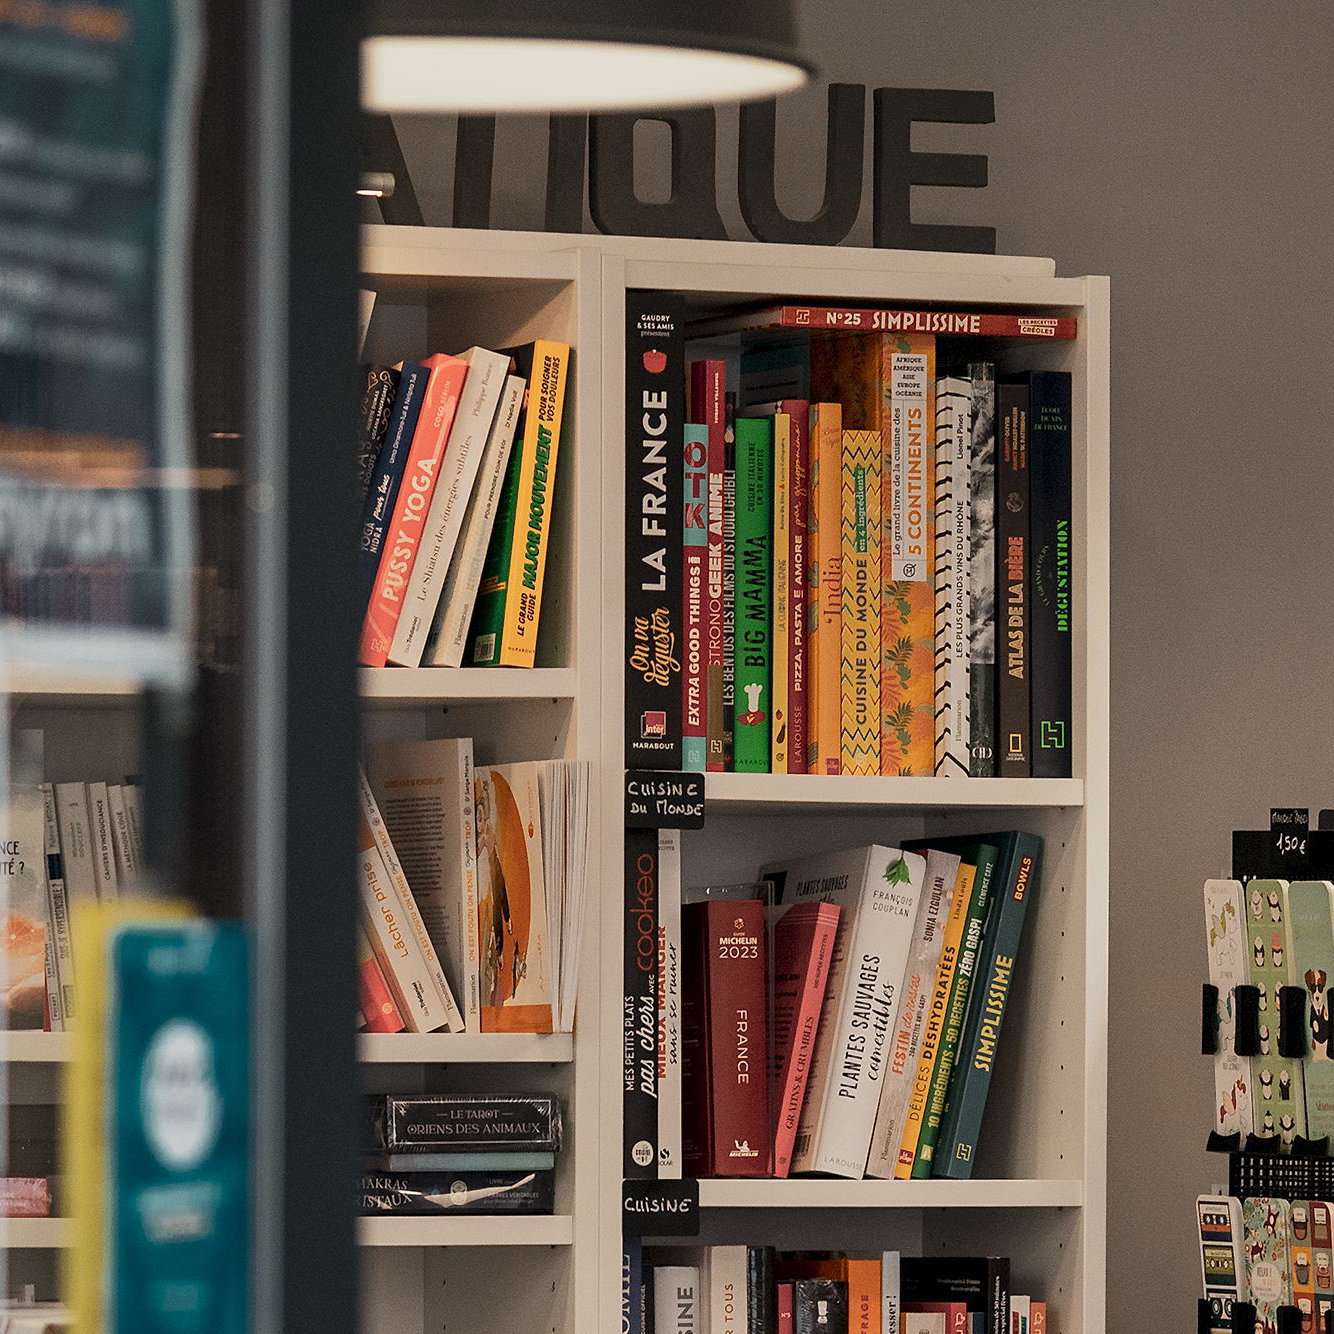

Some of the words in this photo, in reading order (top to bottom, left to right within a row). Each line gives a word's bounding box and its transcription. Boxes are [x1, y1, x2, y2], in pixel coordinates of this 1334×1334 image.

[641, 314, 670, 322] GAUDRY
[872, 311, 980, 332] SIMPLISSIME
[541, 356, 552, 396] SOIGNER
[548, 357, 560, 403] DOULEURS
[539, 397, 549, 422] POUR
[546, 405, 556, 422] VOS
[454, 435, 472, 475] subtiles
[642, 390, 667, 537] FRANCE
[907, 407, 922, 540] CONTINENTS
[528, 424, 552, 532] MOUVEMENT
[438, 478, 461, 522] énergies
[382, 531, 415, 602] PUSSY
[403, 458, 437, 523] YOGA
[433, 524, 447, 543] des
[907, 544, 922, 556] 5
[956, 535, 963, 551] DU
[421, 545, 442, 585] Shiatsu
[522, 530, 541, 590] MAJOR
[642, 547, 667, 591] LA
[741, 535, 767, 621] MAMMA
[794, 535, 803, 585] AMORE
[1004, 536, 1024, 581] BIÈRE
[417, 587, 427, 602] Le
[518, 593, 528, 625] GRAND
[527, 593, 537, 622] GUIDE
[688, 566, 701, 625] THINGS
[857, 559, 866, 622] MONDE
[1008, 583, 1024, 604] LA
[517, 626, 525, 637] LE
[794, 603, 803, 646] PASTA
[1008, 605, 1024, 627] DE
[688, 628, 701, 674] GOOD
[740, 629, 766, 667] BIG
[857, 628, 866, 652] DU
[1008, 630, 1024, 679] ATLAS
[794, 650, 803, 692] PIZZA,
[857, 657, 866, 725] CUISINE
[688, 677, 701, 726] EXTRA
[19, 861, 25, 876] ?
[363, 862, 388, 902] prise
[1014, 857, 1032, 900] BOWLS
[630, 854, 654, 970] cookeo
[928, 876, 944, 916] EZGULIAN
[380, 906, 408, 959] Lâcher
[719, 937, 758, 945] MICHELIN
[923, 917, 937, 942] SONIA
[966, 918, 983, 949] GASPI
[719, 945, 759, 959] 2023
[958, 950, 976, 977] ZÉRO
[625, 995, 635, 1026] PLATS
[851, 954, 880, 1030] SAUVAGES
[949, 978, 970, 1025] RECETTES
[974, 954, 1013, 1072] SIMPLISSIME
[635, 996, 655, 1050] chers
[866, 981, 895, 1082] comestibles
[909, 1066, 930, 1122] DÉLICES
[921, 946, 955, 1060] DÉSHYDRATÉES
[945, 1028, 958, 1043] 50
[625, 1029, 635, 1065] PETITS
[737, 1009, 749, 1084] FRANCE
[839, 1034, 866, 1099] PLANTES
[891, 1030, 911, 1076] FESTIN
[625, 1070, 635, 1091] MES
[641, 1055, 656, 1098] pas
[784, 1084, 803, 1130] GRATINS
[796, 1016, 814, 1074] CRUMBLES
[930, 1049, 954, 1115] INGRÉDIENTS
[407, 1124, 454, 1135] ORIENS
[456, 1124, 480, 1134] DES
[484, 1123, 541, 1135] ANIMAUX
[450, 1110, 464, 1119] LE
[465, 1110, 499, 1119] TAROT
[928, 1117, 940, 1128] 10
